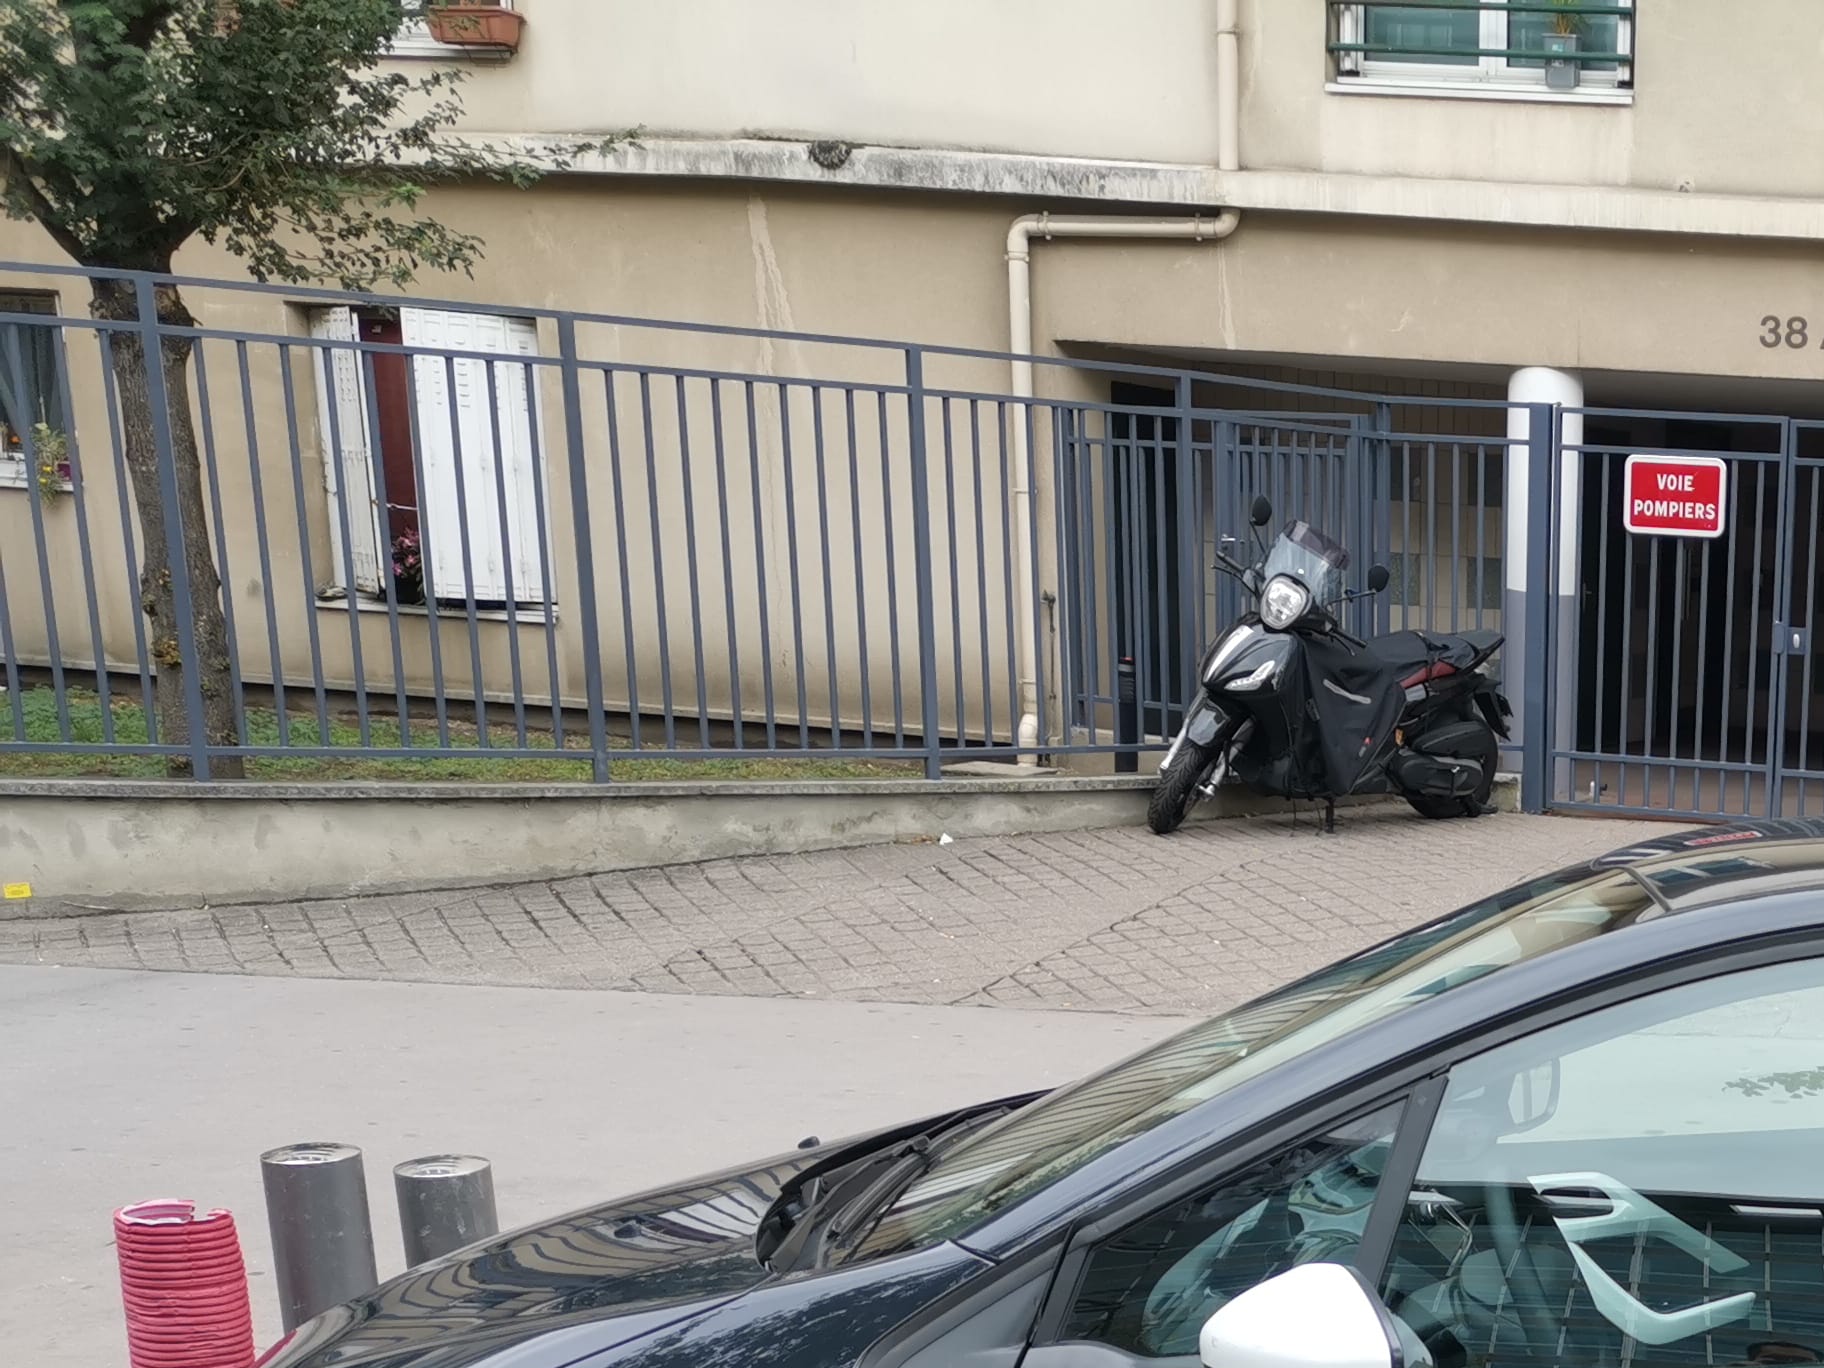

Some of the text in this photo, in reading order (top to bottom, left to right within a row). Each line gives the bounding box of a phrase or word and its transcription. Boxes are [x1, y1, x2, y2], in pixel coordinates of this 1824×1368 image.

[1759, 315, 1808, 349] 38
[1656, 473, 1695, 491] VOIE
[1633, 499, 1716, 520] POMPIERS
